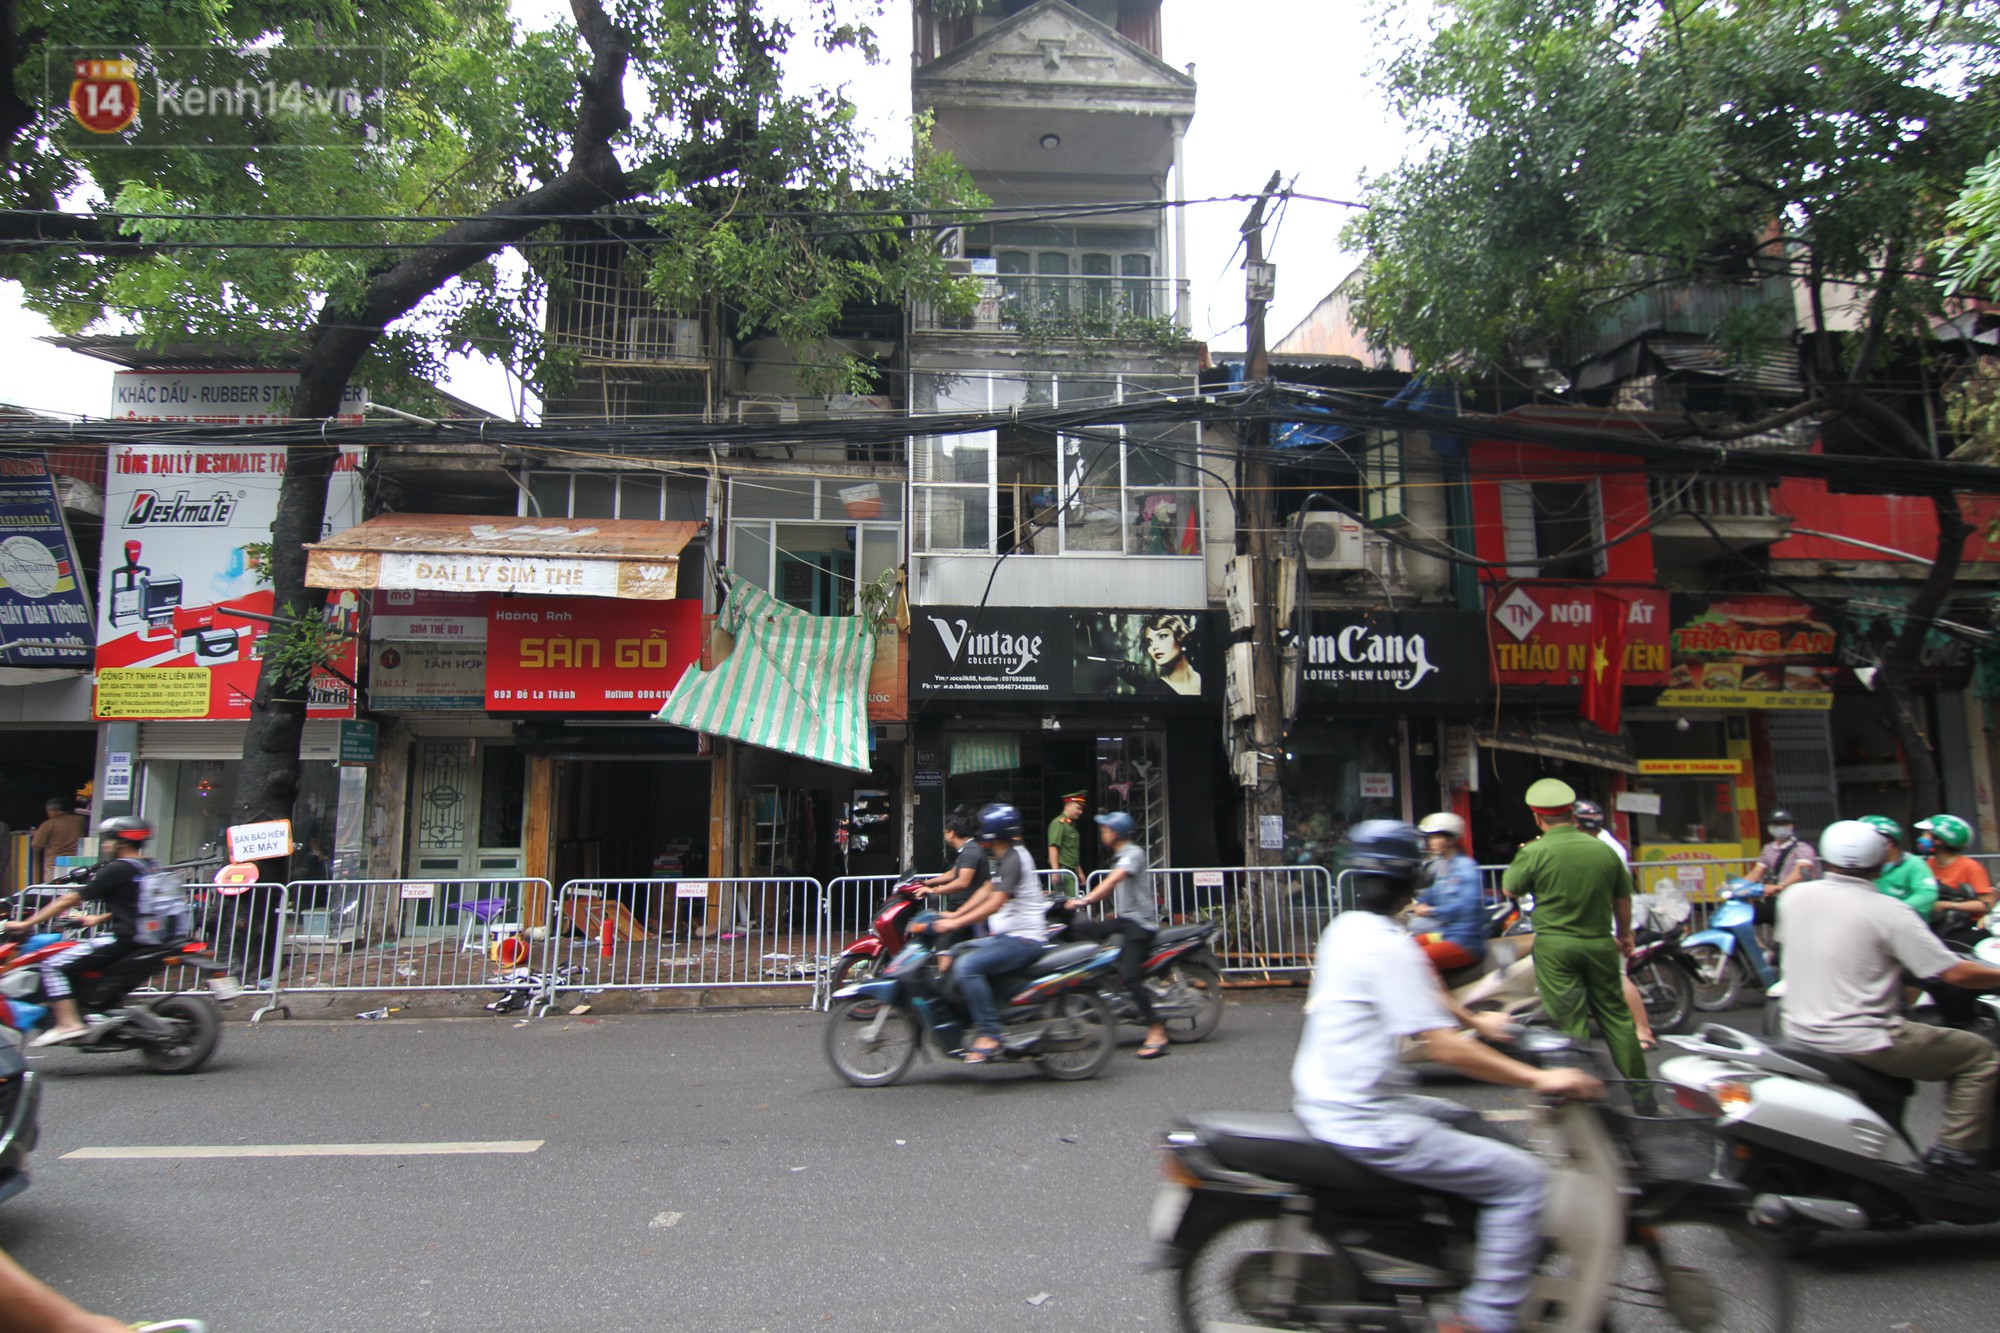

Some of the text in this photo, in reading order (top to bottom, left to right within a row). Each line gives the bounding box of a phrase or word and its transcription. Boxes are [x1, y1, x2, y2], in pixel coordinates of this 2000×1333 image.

[118, 378, 156, 404] KHẮC
[159, 379, 189, 404] DẤU
[201, 386, 259, 404] RUBBER
[116, 446, 148, 474] TỔNG
[151, 452, 174, 478] ĐẠI
[176, 449, 192, 474] LÝ
[195, 452, 267, 474] DESKMATE
[269, 452, 287, 477] TẠ
[125, 491, 234, 526] Deskmate
[415, 561, 585, 586] ĐẠI LÝ SIM THẺ
[546, 611, 573, 621] Anh
[1551, 600, 1592, 628] NỘI
[409, 622, 464, 635] SIM THẺ 891
[519, 628, 668, 669] SÀN GỖ
[927, 615, 1043, 675] Vintage
[1496, 634, 1561, 670] THẢO
[1789, 631, 1837, 654] AN
[967, 657, 1018, 665] COLLECTION
[101, 670, 207, 681] CÔNG TY TNHH AE LIÊN MINH
[1377, 669, 1411, 681] LOOKS
[533, 690, 544, 699] La
[547, 688, 576, 700] Thành
[604, 690, 634, 699] Hotline
[233, 832, 250, 844] BÁN
[242, 840, 279, 854] XE MÁY
